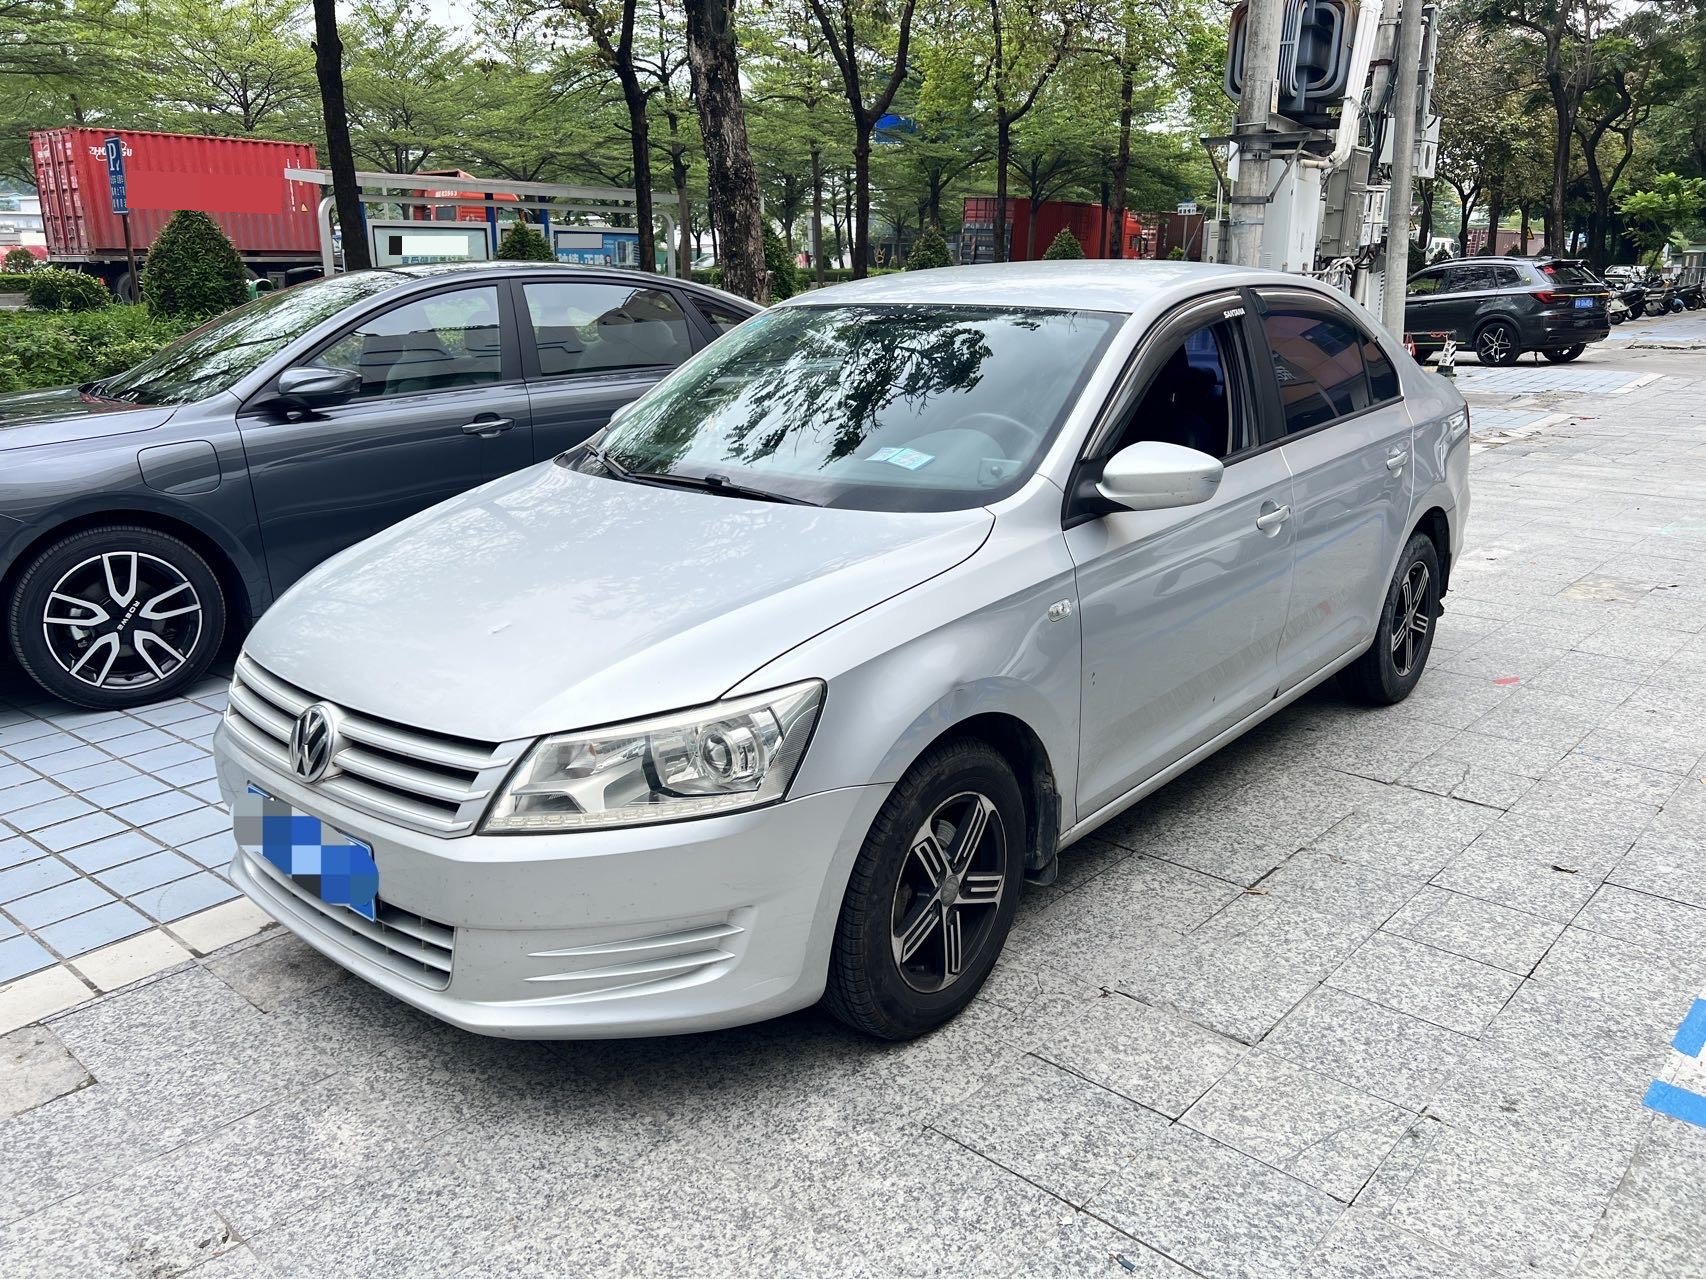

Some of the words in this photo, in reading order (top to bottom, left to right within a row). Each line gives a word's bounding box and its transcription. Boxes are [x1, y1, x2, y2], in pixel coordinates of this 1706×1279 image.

[107, 143, 117, 171] P
[1223, 307, 1246, 319] SANTANA
[116, 600, 141, 631] ROEWE
